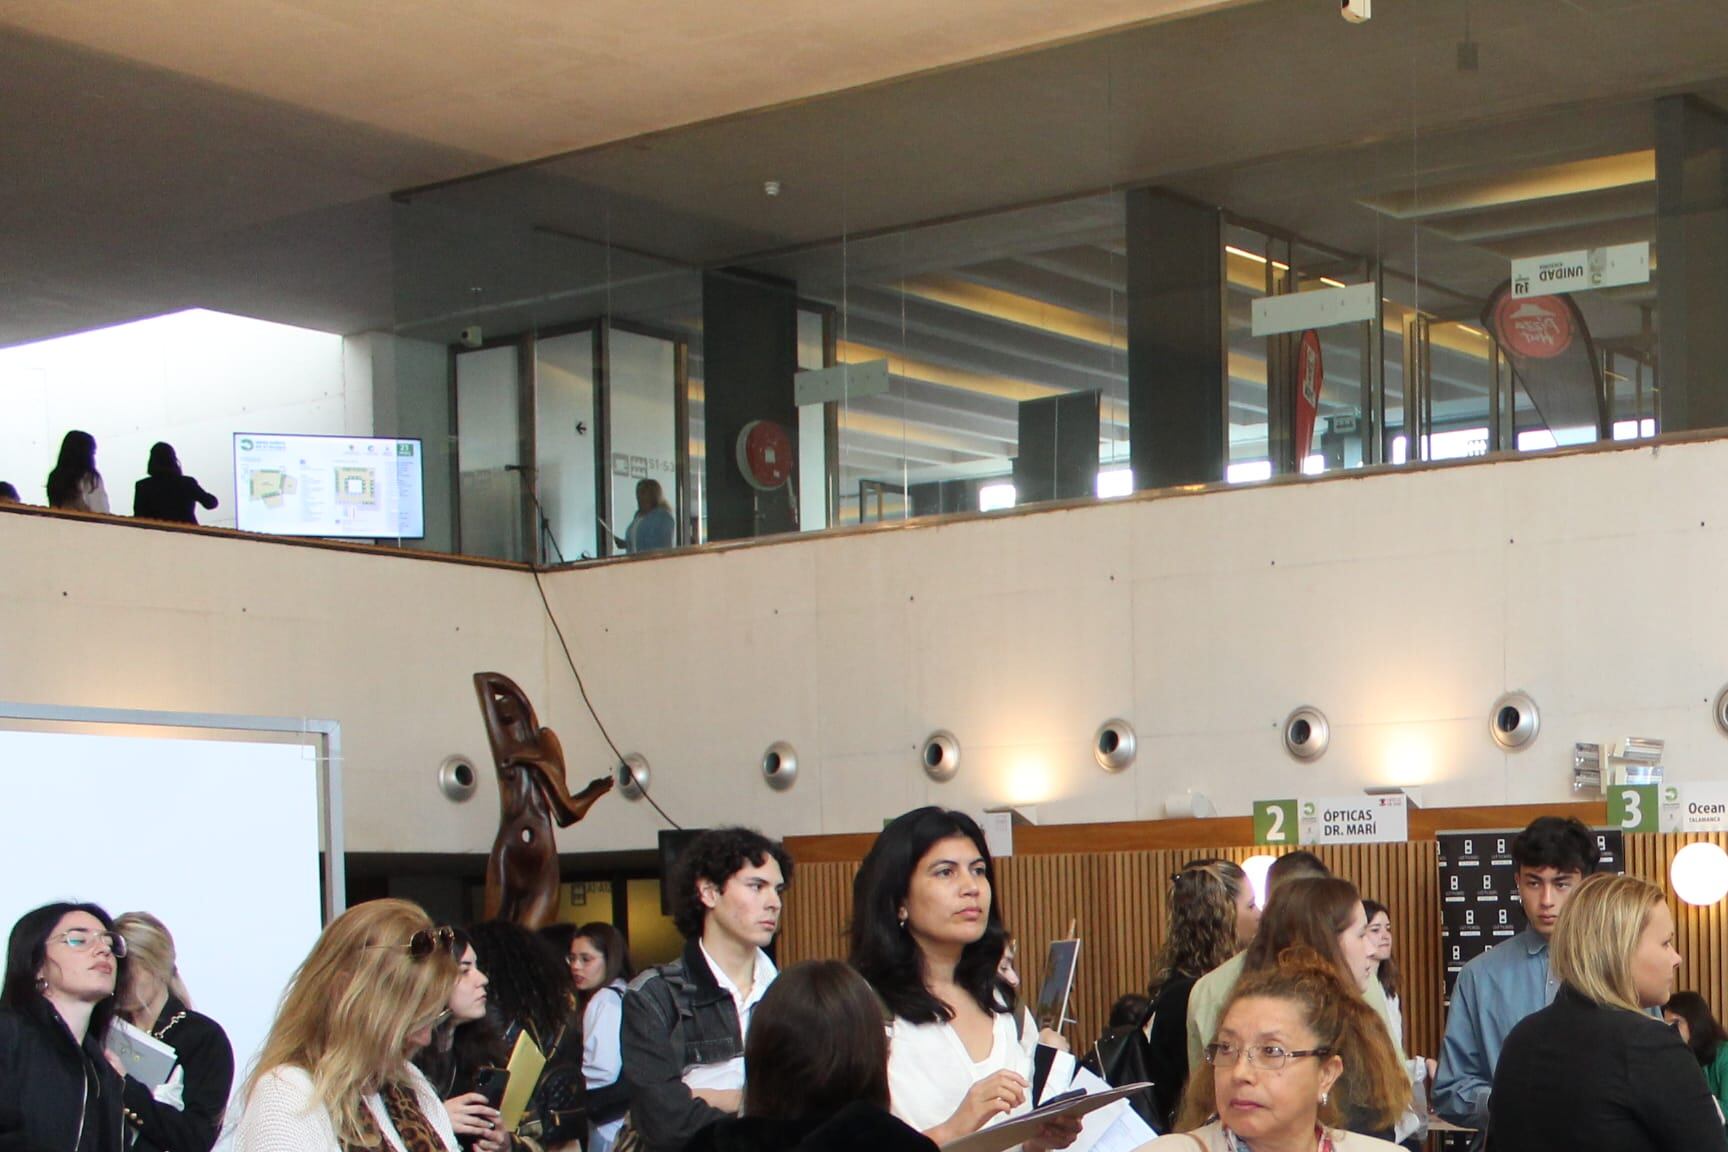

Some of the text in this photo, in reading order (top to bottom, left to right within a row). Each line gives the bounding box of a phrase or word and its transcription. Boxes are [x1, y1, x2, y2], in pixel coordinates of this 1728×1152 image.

[1539, 265, 1584, 282] UNIDAD
[1323, 808, 1373, 823] ÓPTICAS
[1621, 790, 1643, 829] 3
[1688, 802, 1725, 815] Ocean
[1266, 805, 1286, 842] 2
[1323, 821, 1377, 837] DR. MARÍ
